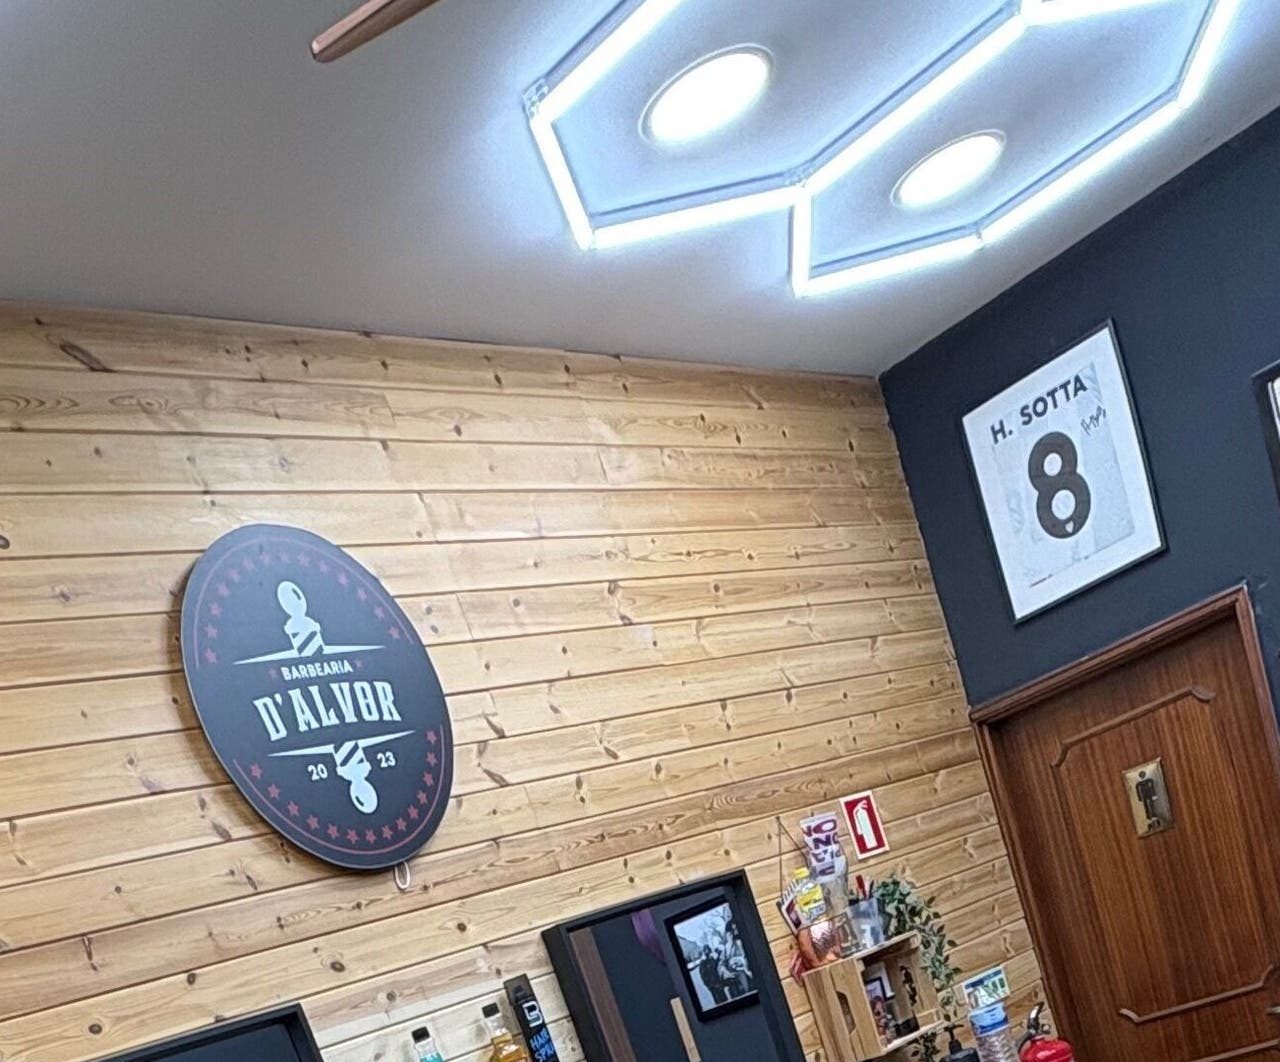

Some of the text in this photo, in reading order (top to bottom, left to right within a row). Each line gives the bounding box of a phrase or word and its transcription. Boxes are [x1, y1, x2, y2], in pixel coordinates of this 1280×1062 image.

[990, 419, 1013, 445] H.
[1020, 374, 1088, 426] SOTTA
[1028, 431, 1091, 538] 8
[280, 659, 353, 681] BARBEARIA
[253, 681, 402, 742] D'ALVOR
[308, 751, 396, 781] 20 23
